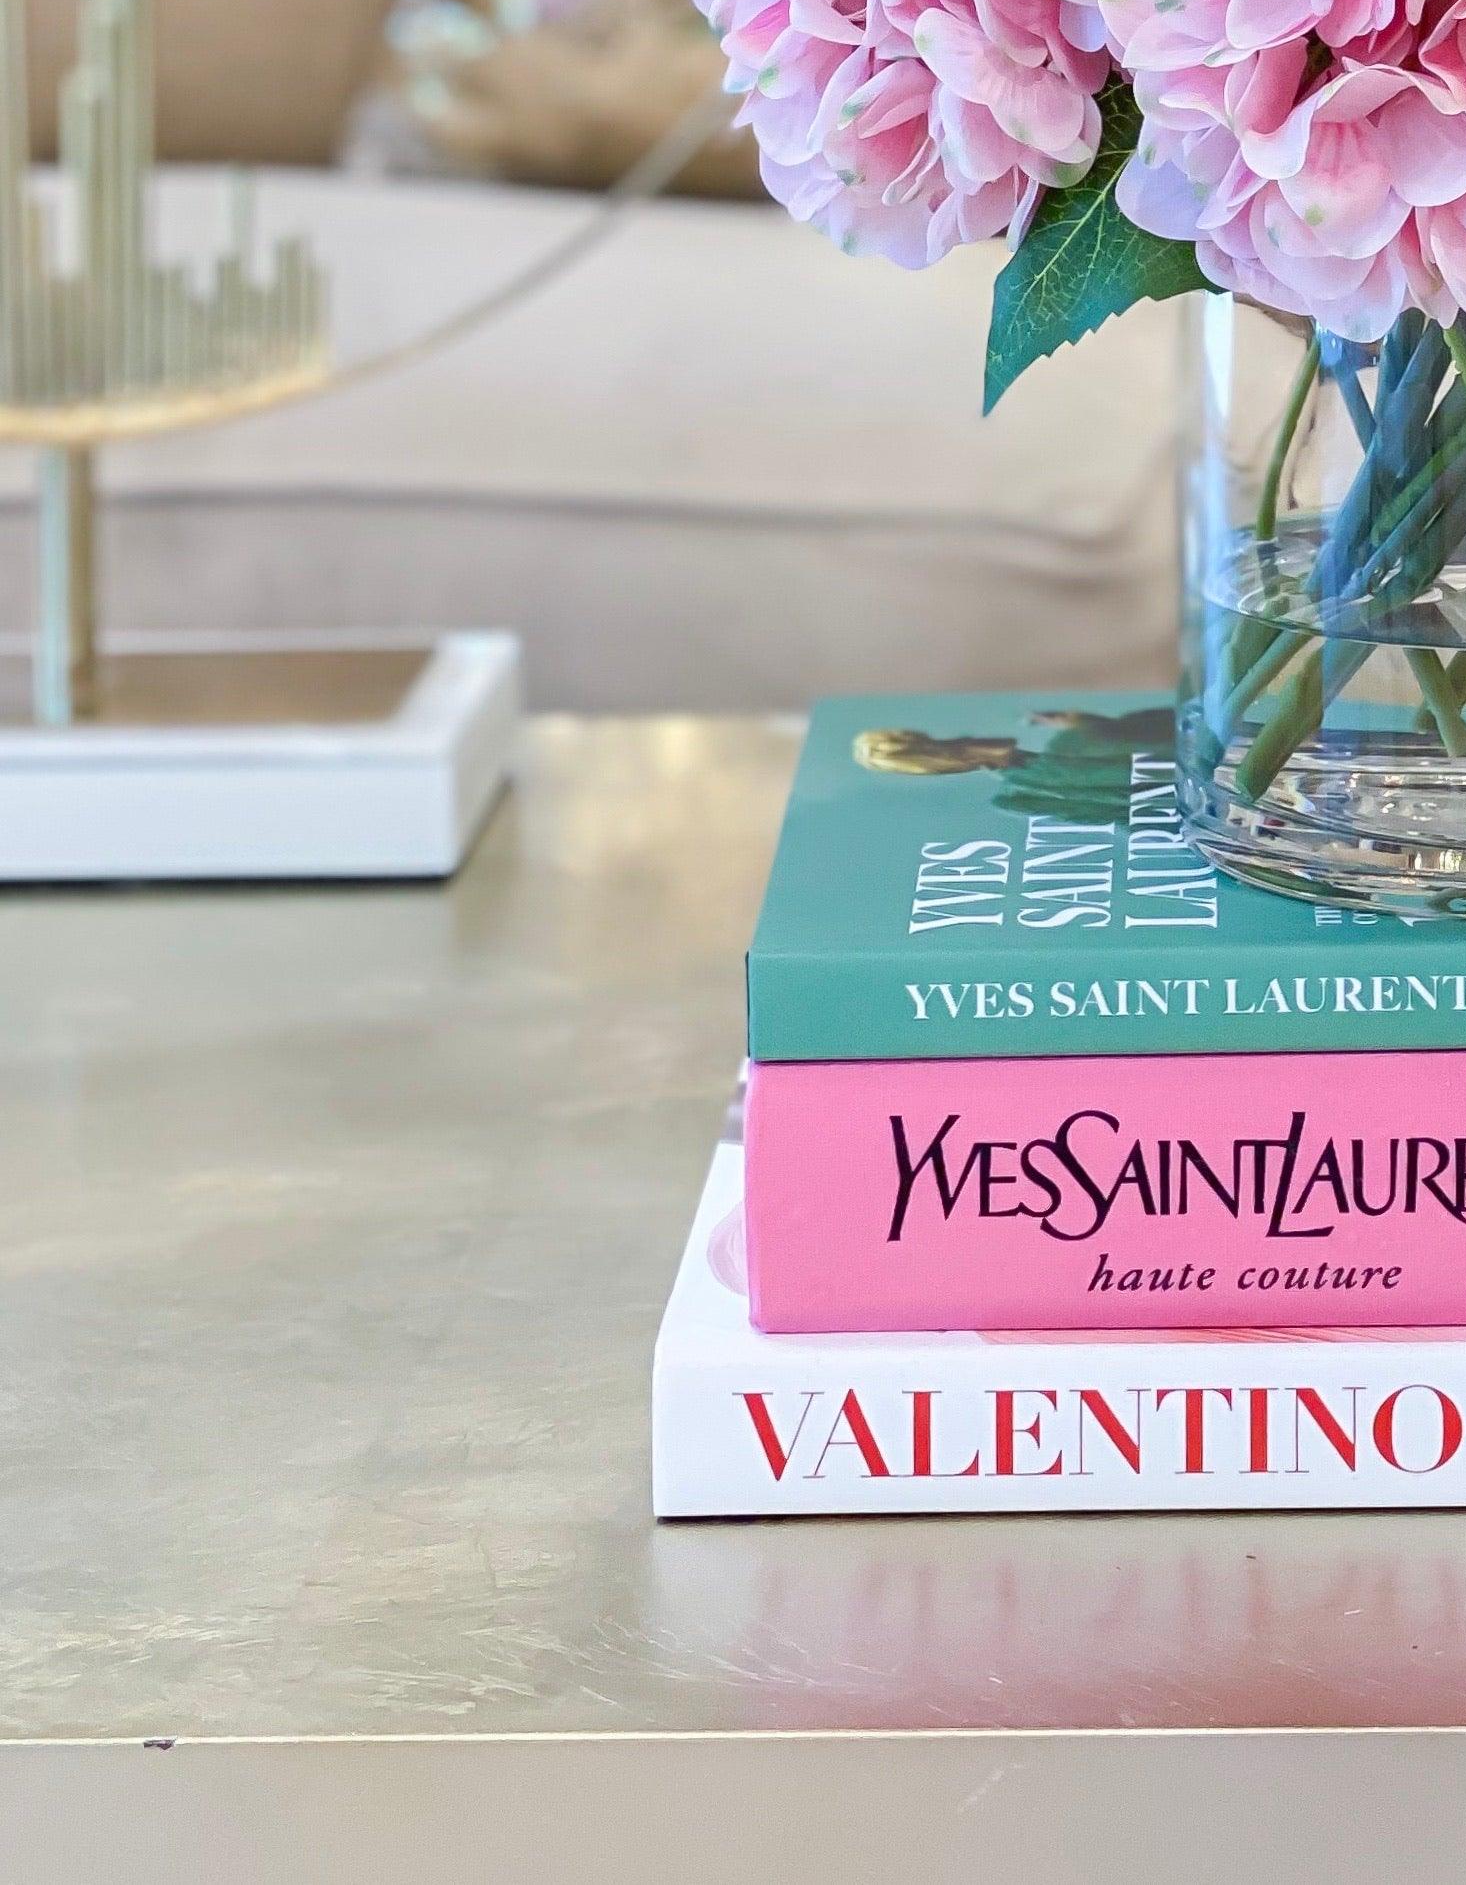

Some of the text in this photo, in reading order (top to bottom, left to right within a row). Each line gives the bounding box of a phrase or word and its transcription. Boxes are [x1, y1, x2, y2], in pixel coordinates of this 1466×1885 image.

[909, 840, 1011, 934] YVES
[1017, 816, 1116, 929] SAINT
[905, 981, 1034, 1019] YVES
[1050, 979, 1210, 1016] SAINT
[1087, 1253, 1403, 1293] haute couture
[732, 1384, 1464, 1482] VALENTINO
